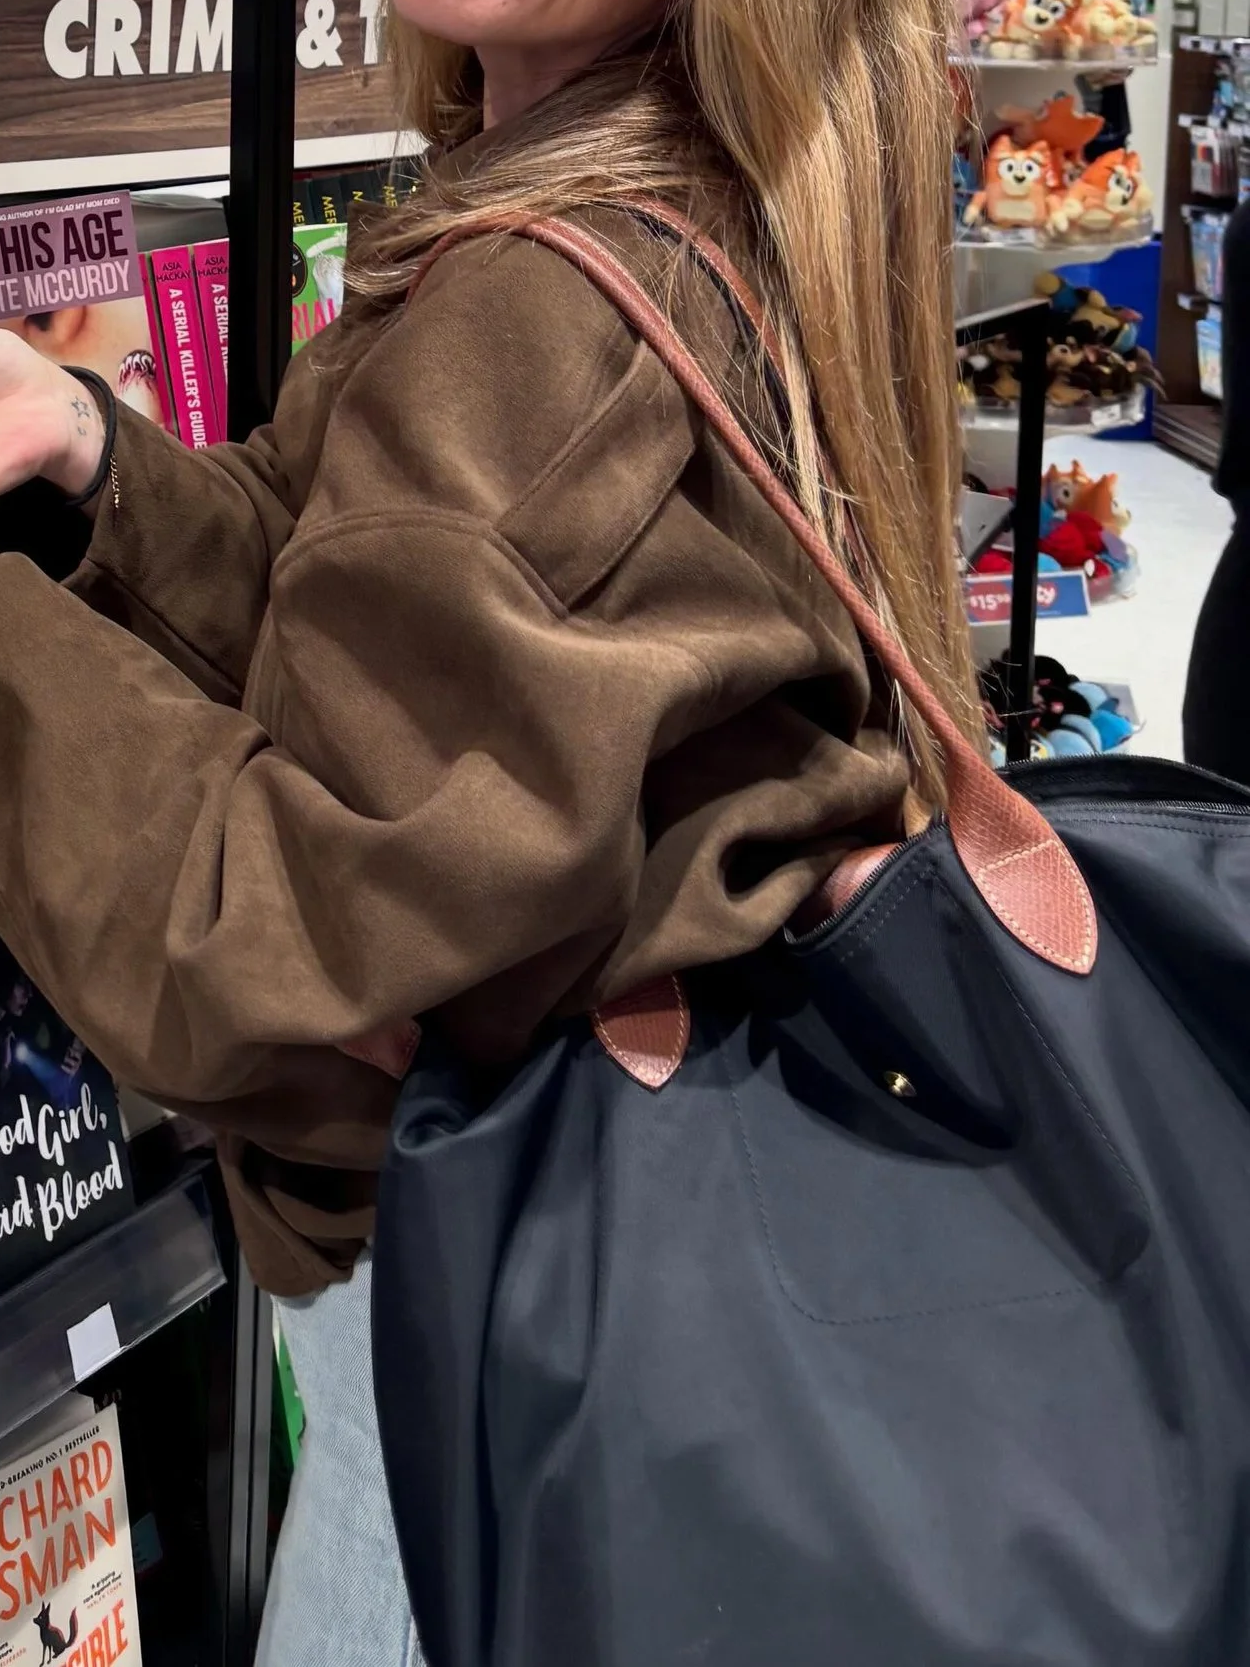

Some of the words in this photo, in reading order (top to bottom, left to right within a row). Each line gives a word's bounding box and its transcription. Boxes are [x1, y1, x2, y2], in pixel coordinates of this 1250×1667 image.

[7, 210, 33, 221] AUTHOR
[63, 210, 129, 265] AGE
[156, 270, 191, 283] MACKAY
[162, 262, 182, 272] ASIA
[205, 255, 225, 266] ASIA
[24, 259, 130, 308] MCCURDY
[169, 288, 183, 299] A
[171, 300, 189, 348] SERIAL
[179, 349, 201, 408] KILLER'S
[189, 410, 209, 450] GUIDE
[36, 1082, 108, 1166] Girl,
[36, 1139, 124, 1242] Blood
[64, 1425, 100, 1456] BESTSELLER
